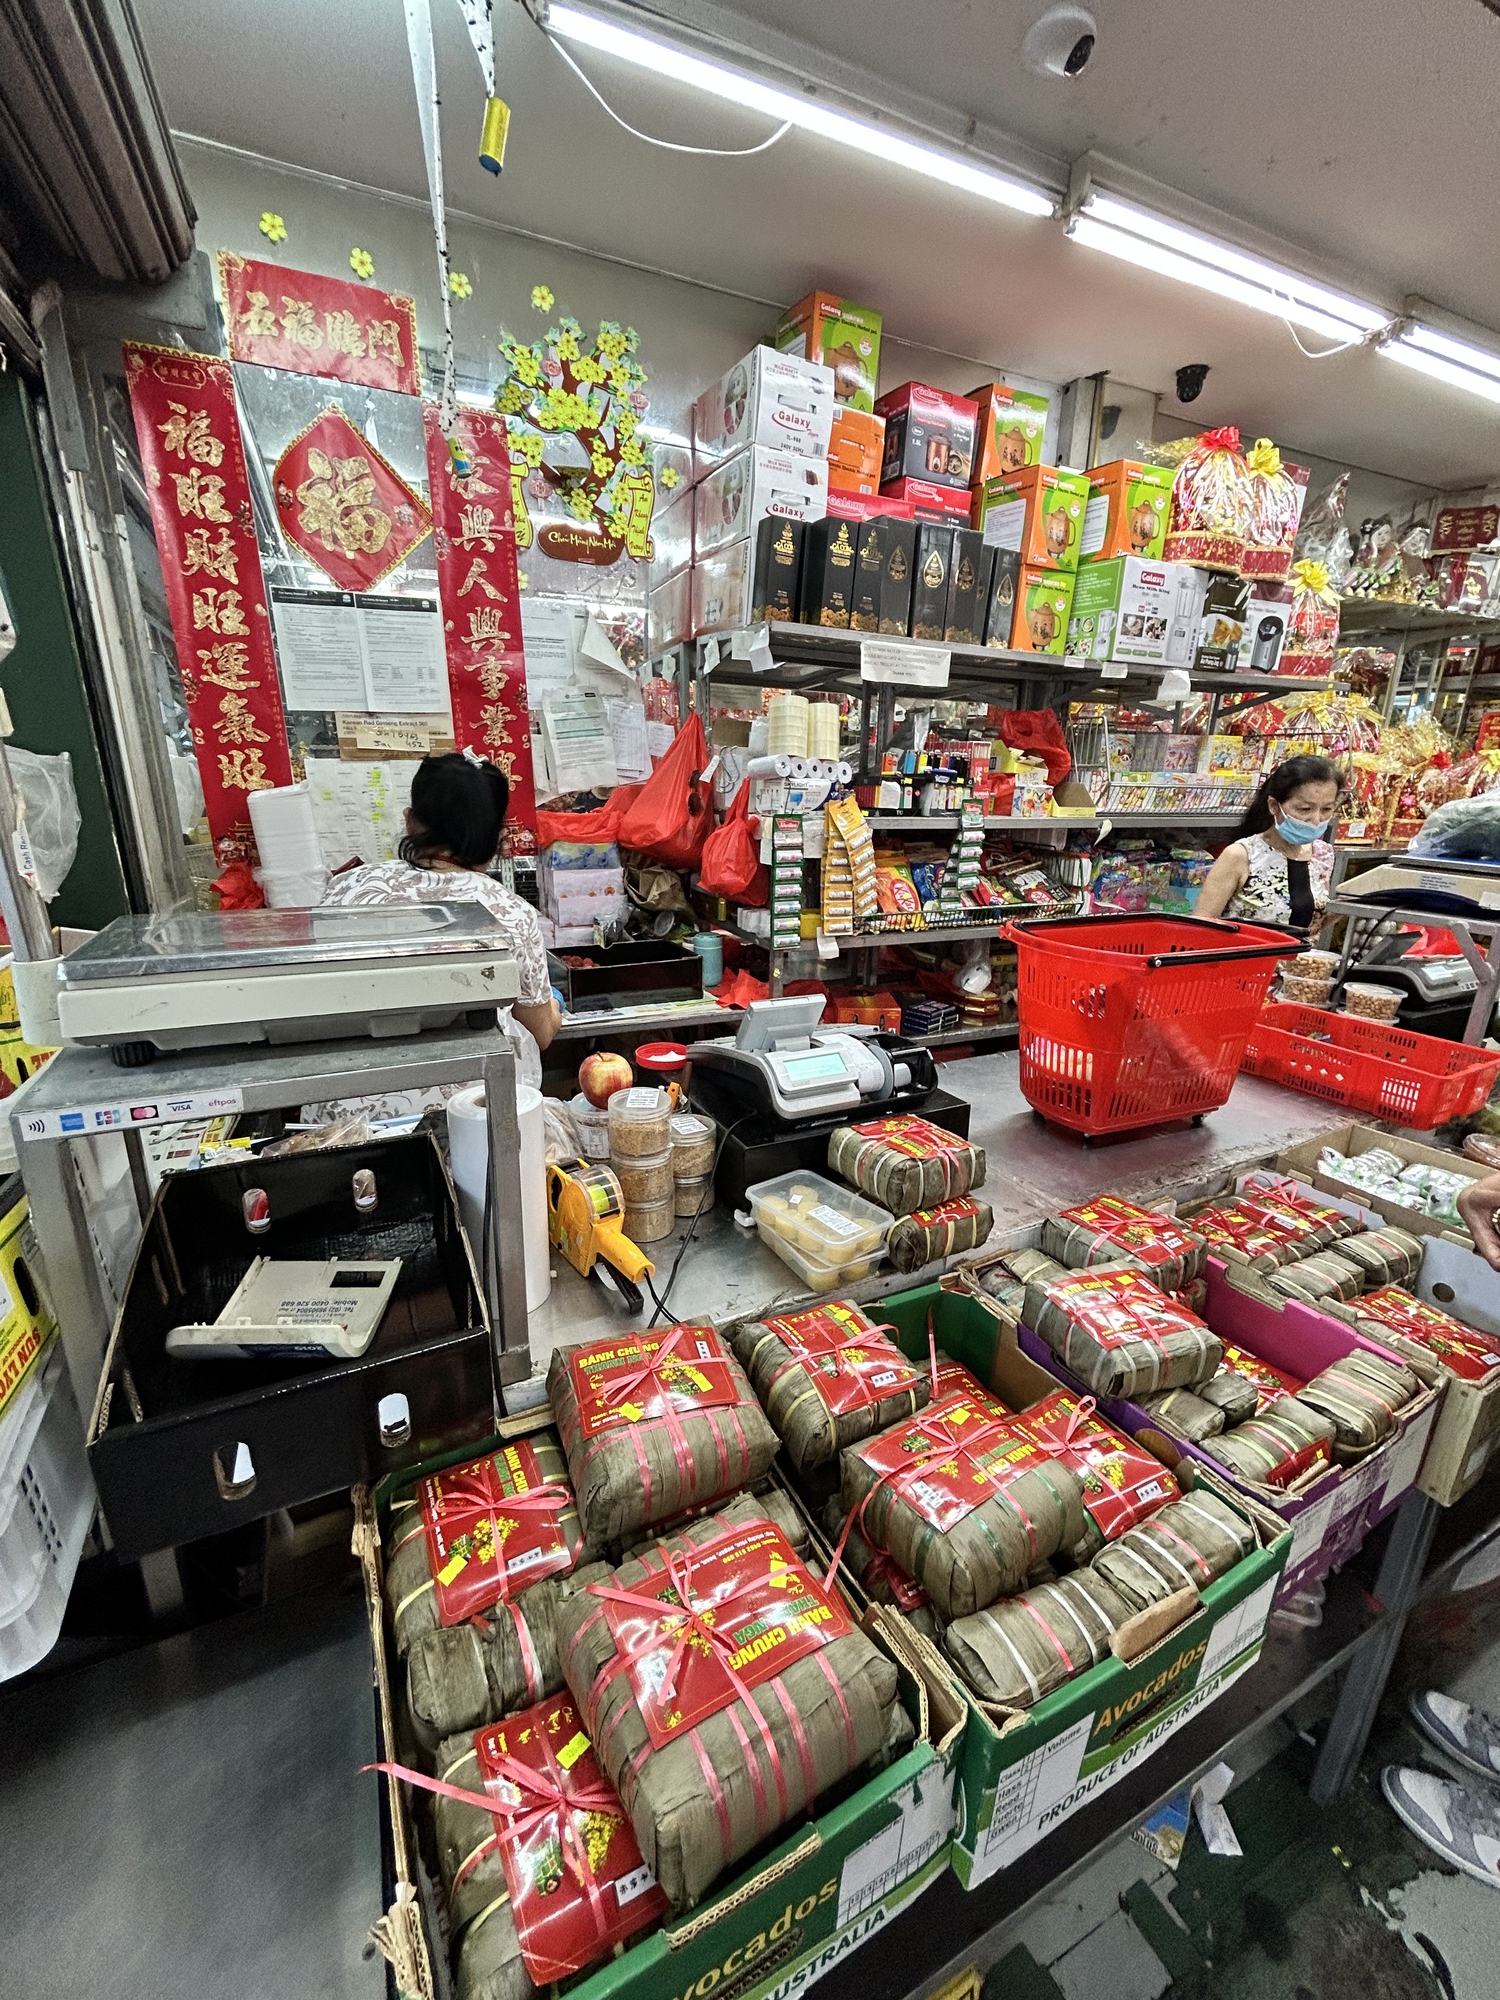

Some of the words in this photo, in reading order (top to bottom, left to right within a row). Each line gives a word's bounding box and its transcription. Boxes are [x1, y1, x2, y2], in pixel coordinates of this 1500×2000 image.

[820, 302, 841, 316] Galaxy
[238, 290, 405, 368] 五福臨門
[996, 394, 1014, 406] Galaxy
[778, 410, 811, 429] Galaxy
[1042, 474, 1059, 487] Galaxy
[1127, 469, 1143, 481] Galaxy
[296, 447, 393, 560] 福
[772, 503, 805, 519] Galaxy
[828, 494, 866, 512] Galaxy
[1026, 573, 1043, 583] Galaxy
[1141, 572, 1165, 587] Galaxy
[1158, 587, 1170, 595] King
[342, 719, 363, 727] Korean
[376, 720, 399, 728] Ginseng
[22, 848, 31, 871] Cash
[171, 1103, 192, 1113] VISA
[208, 1097, 236, 1109] eftpos
[17, 1327, 41, 1367] SUN
[579, 1349, 615, 1369] BÁNH
[584, 1356, 625, 1376] THANH
[590, 1411, 608, 1422] Phone:
[503, 1446, 522, 1472] BÁNH
[1004, 1444, 1038, 1466] BÁNH
[735, 1538, 749, 1549] rice,
[748, 1533, 766, 1544] sticky
[761, 1537, 781, 1549] Phone:
[699, 1552, 716, 1565] bean,
[715, 1544, 735, 1558] sugar,
[786, 1605, 834, 1632] BÁNH
[733, 1618, 767, 1645] NGA
[1093, 1639, 1207, 1737] Avocados
[1045, 1725, 1083, 1754] Volume
[1037, 1762, 1118, 1830] PRODUCE
[1121, 1744, 1142, 1766] OF
[1140, 1679, 1221, 1752] AUSTRALIA
[1000, 1766, 1023, 1784] Class
[997, 1780, 1023, 1800] Hass
[995, 1793, 1021, 1813] Reed
[992, 1803, 1025, 1828] Fuerte
[989, 1815, 1019, 1840] Gwen
